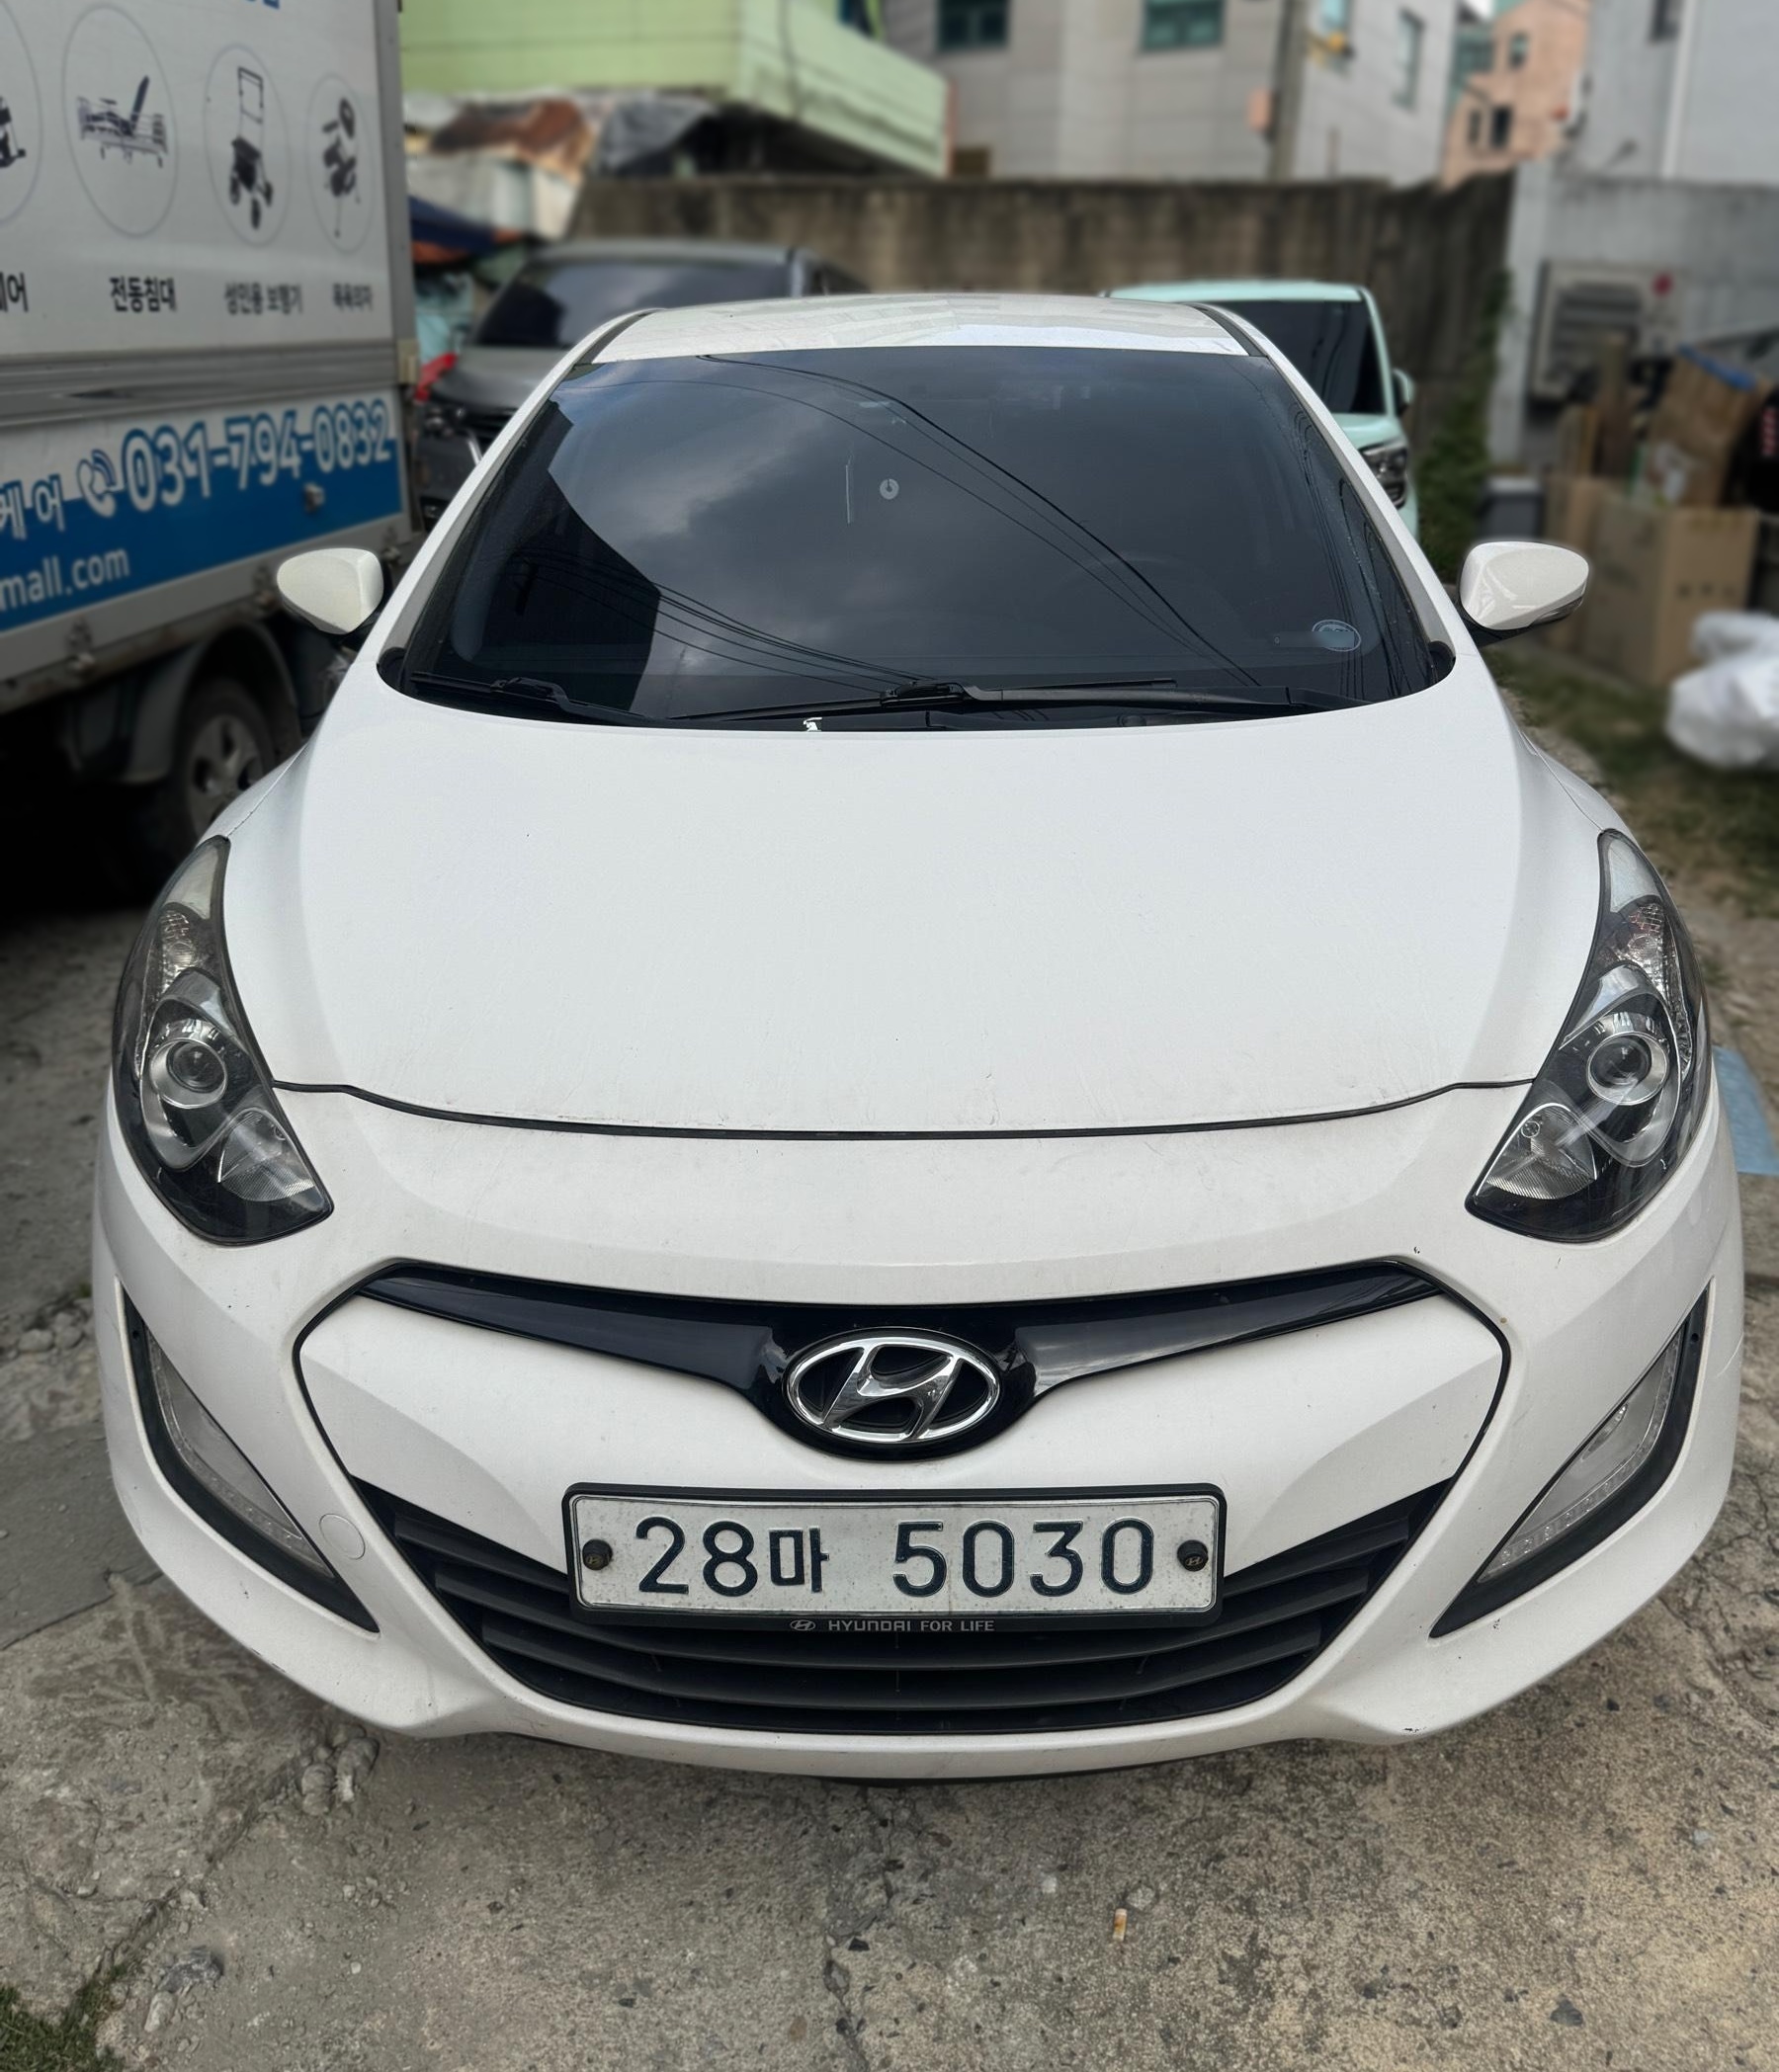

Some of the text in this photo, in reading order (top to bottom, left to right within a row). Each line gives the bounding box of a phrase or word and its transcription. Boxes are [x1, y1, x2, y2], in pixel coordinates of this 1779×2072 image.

[110, 276, 176, 312] 전동침대
[122, 398, 392, 512] 031-794-0832
[635, 1516, 1154, 1598] 28마 5030
[828, 1619, 995, 1631] HYUNDAI FOR LIFE
